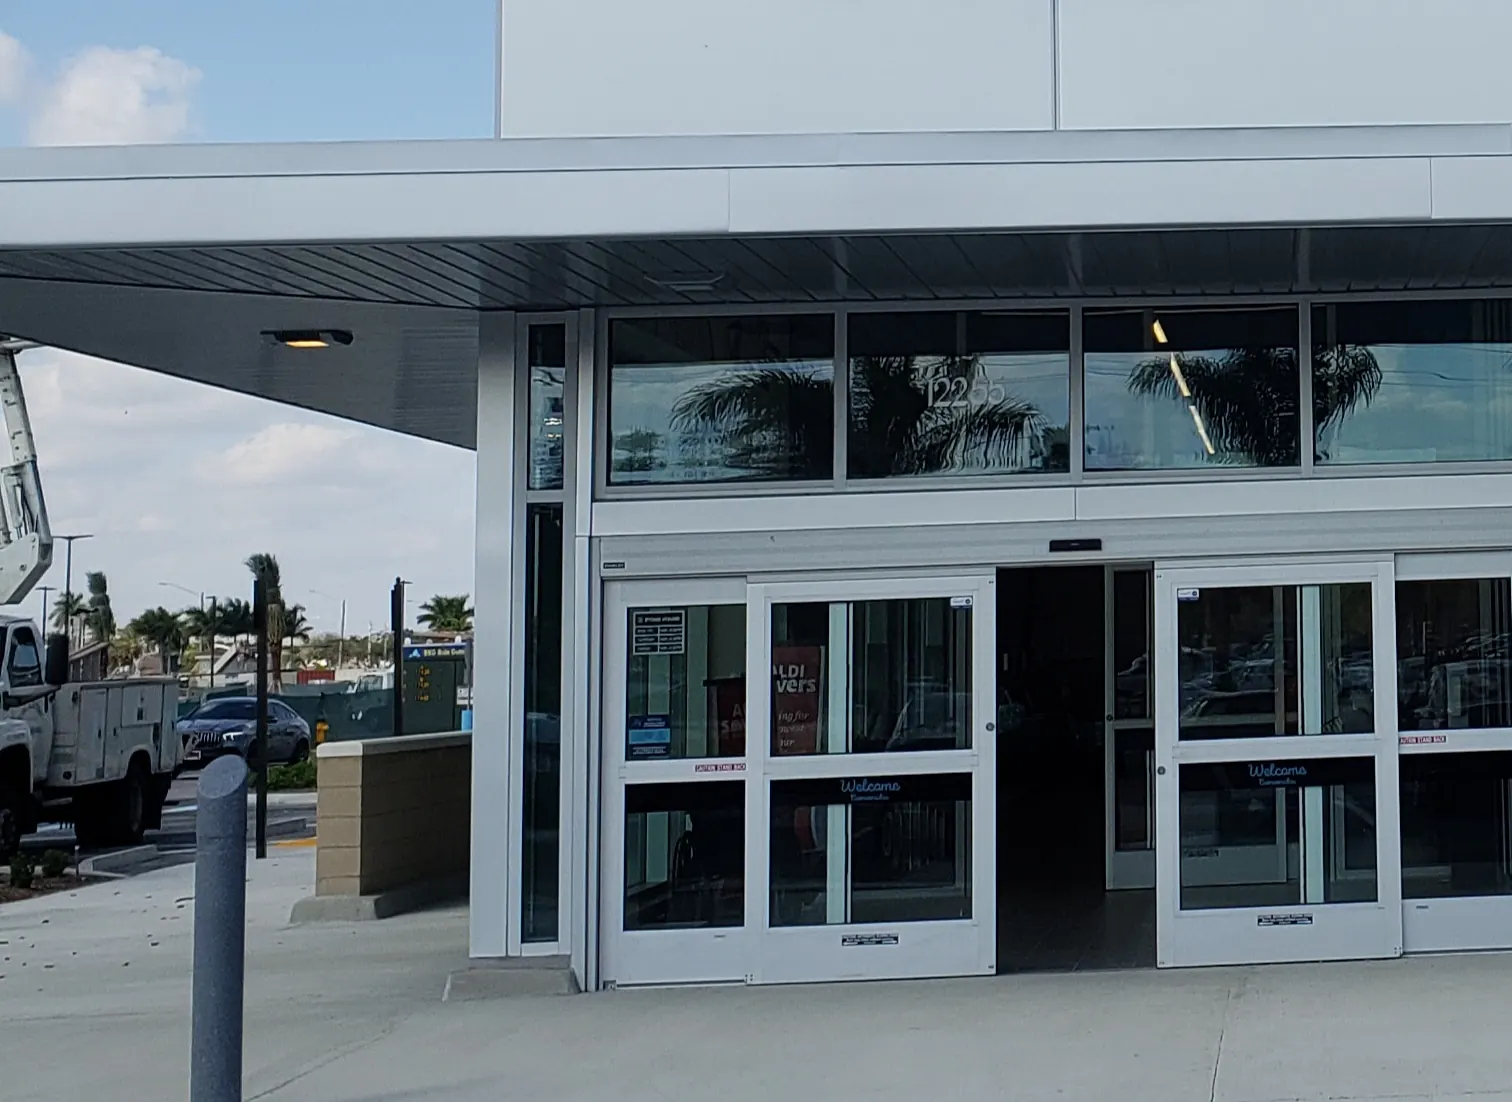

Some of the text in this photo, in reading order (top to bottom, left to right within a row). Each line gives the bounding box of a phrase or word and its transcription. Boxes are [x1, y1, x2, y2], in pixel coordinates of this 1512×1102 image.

[776, 679, 817, 693] vers
[1400, 736, 1416, 744] AUTION
[1248, 763, 1307, 777] Welcome
[840, 778, 901, 792] Welcome
